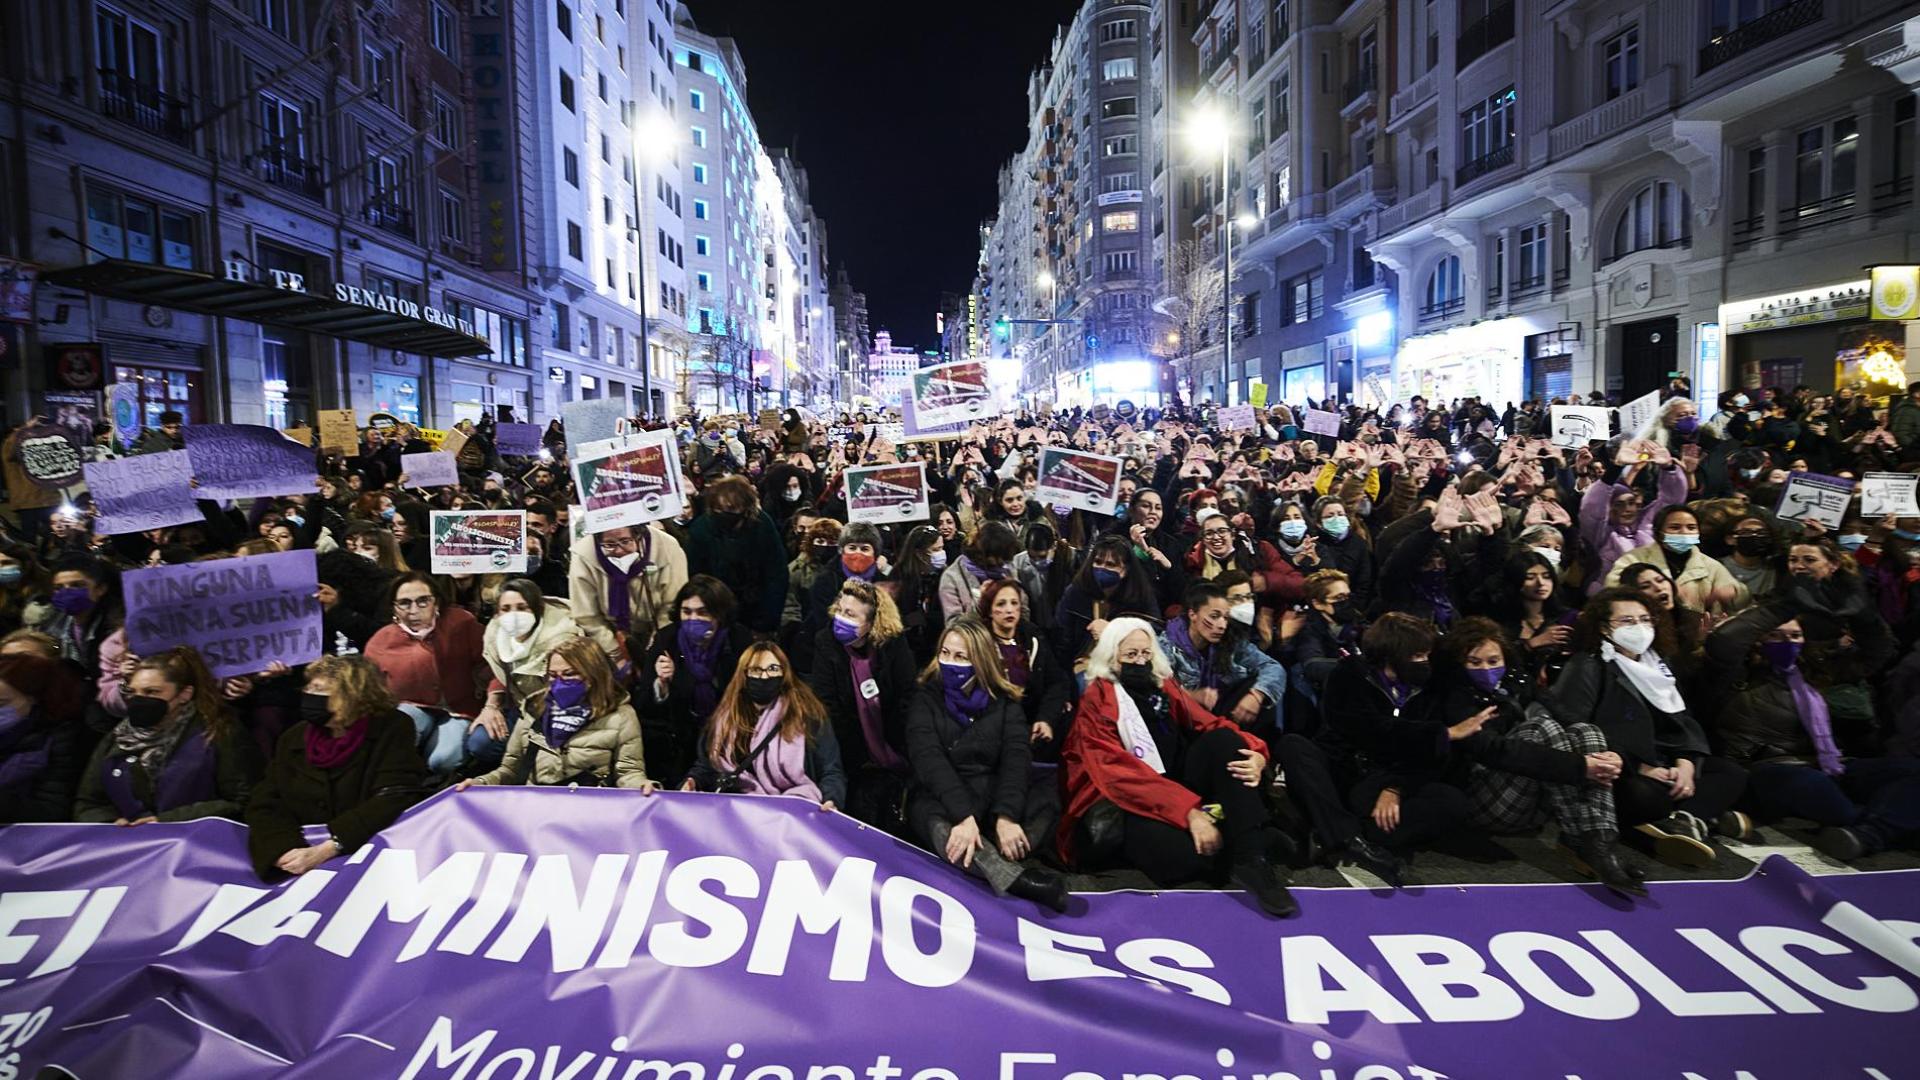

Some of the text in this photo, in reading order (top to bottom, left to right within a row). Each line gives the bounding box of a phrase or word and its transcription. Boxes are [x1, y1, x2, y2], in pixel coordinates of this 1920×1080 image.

[336, 283, 420, 319] SENATOR
[424, 305, 456, 329] GRAN
[595, 467, 664, 485] ABOLICIONISTA
[439, 522, 515, 546] LEY ABOLICIONISTA
[132, 564, 275, 607] NINGUNA
[136, 590, 320, 642] NIÑA SUEÑA
[203, 627, 320, 668] SER PUTA
